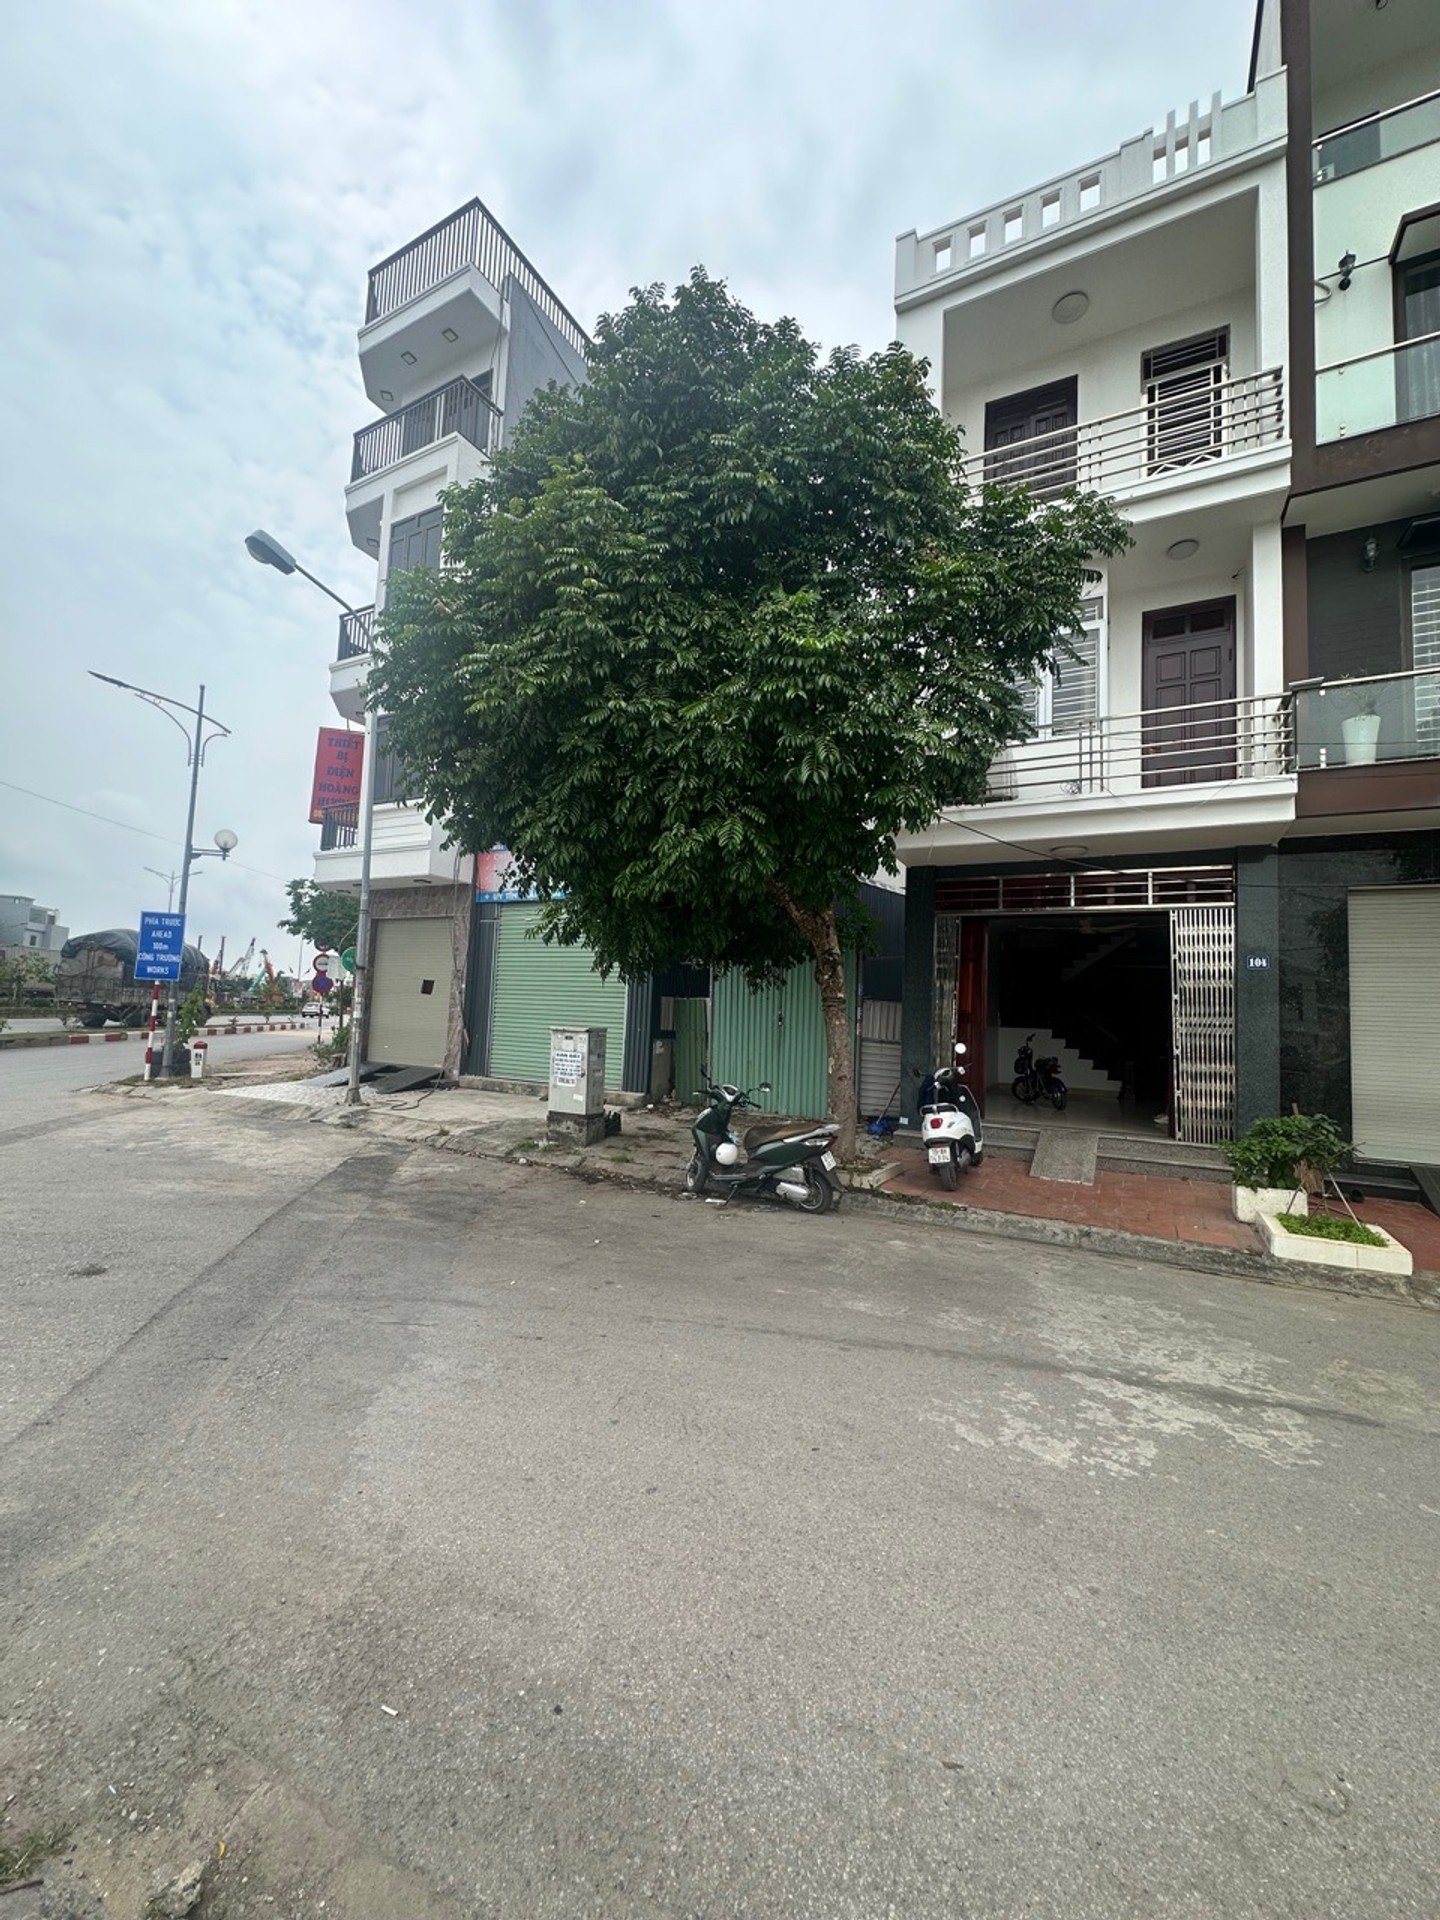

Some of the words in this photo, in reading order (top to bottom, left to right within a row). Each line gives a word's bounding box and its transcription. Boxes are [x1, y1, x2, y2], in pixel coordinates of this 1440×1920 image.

[328, 736, 359, 750] THIẾT
[336, 751, 348, 763] BỊ
[318, 781, 359, 796] HOÀNG
[144, 915, 159, 925] PHÍA
[151, 930, 173, 939] AHEAD
[137, 952, 155, 962] CÔNG
[1249, 957, 1267, 968] 104
[147, 966, 170, 975] WORKS
